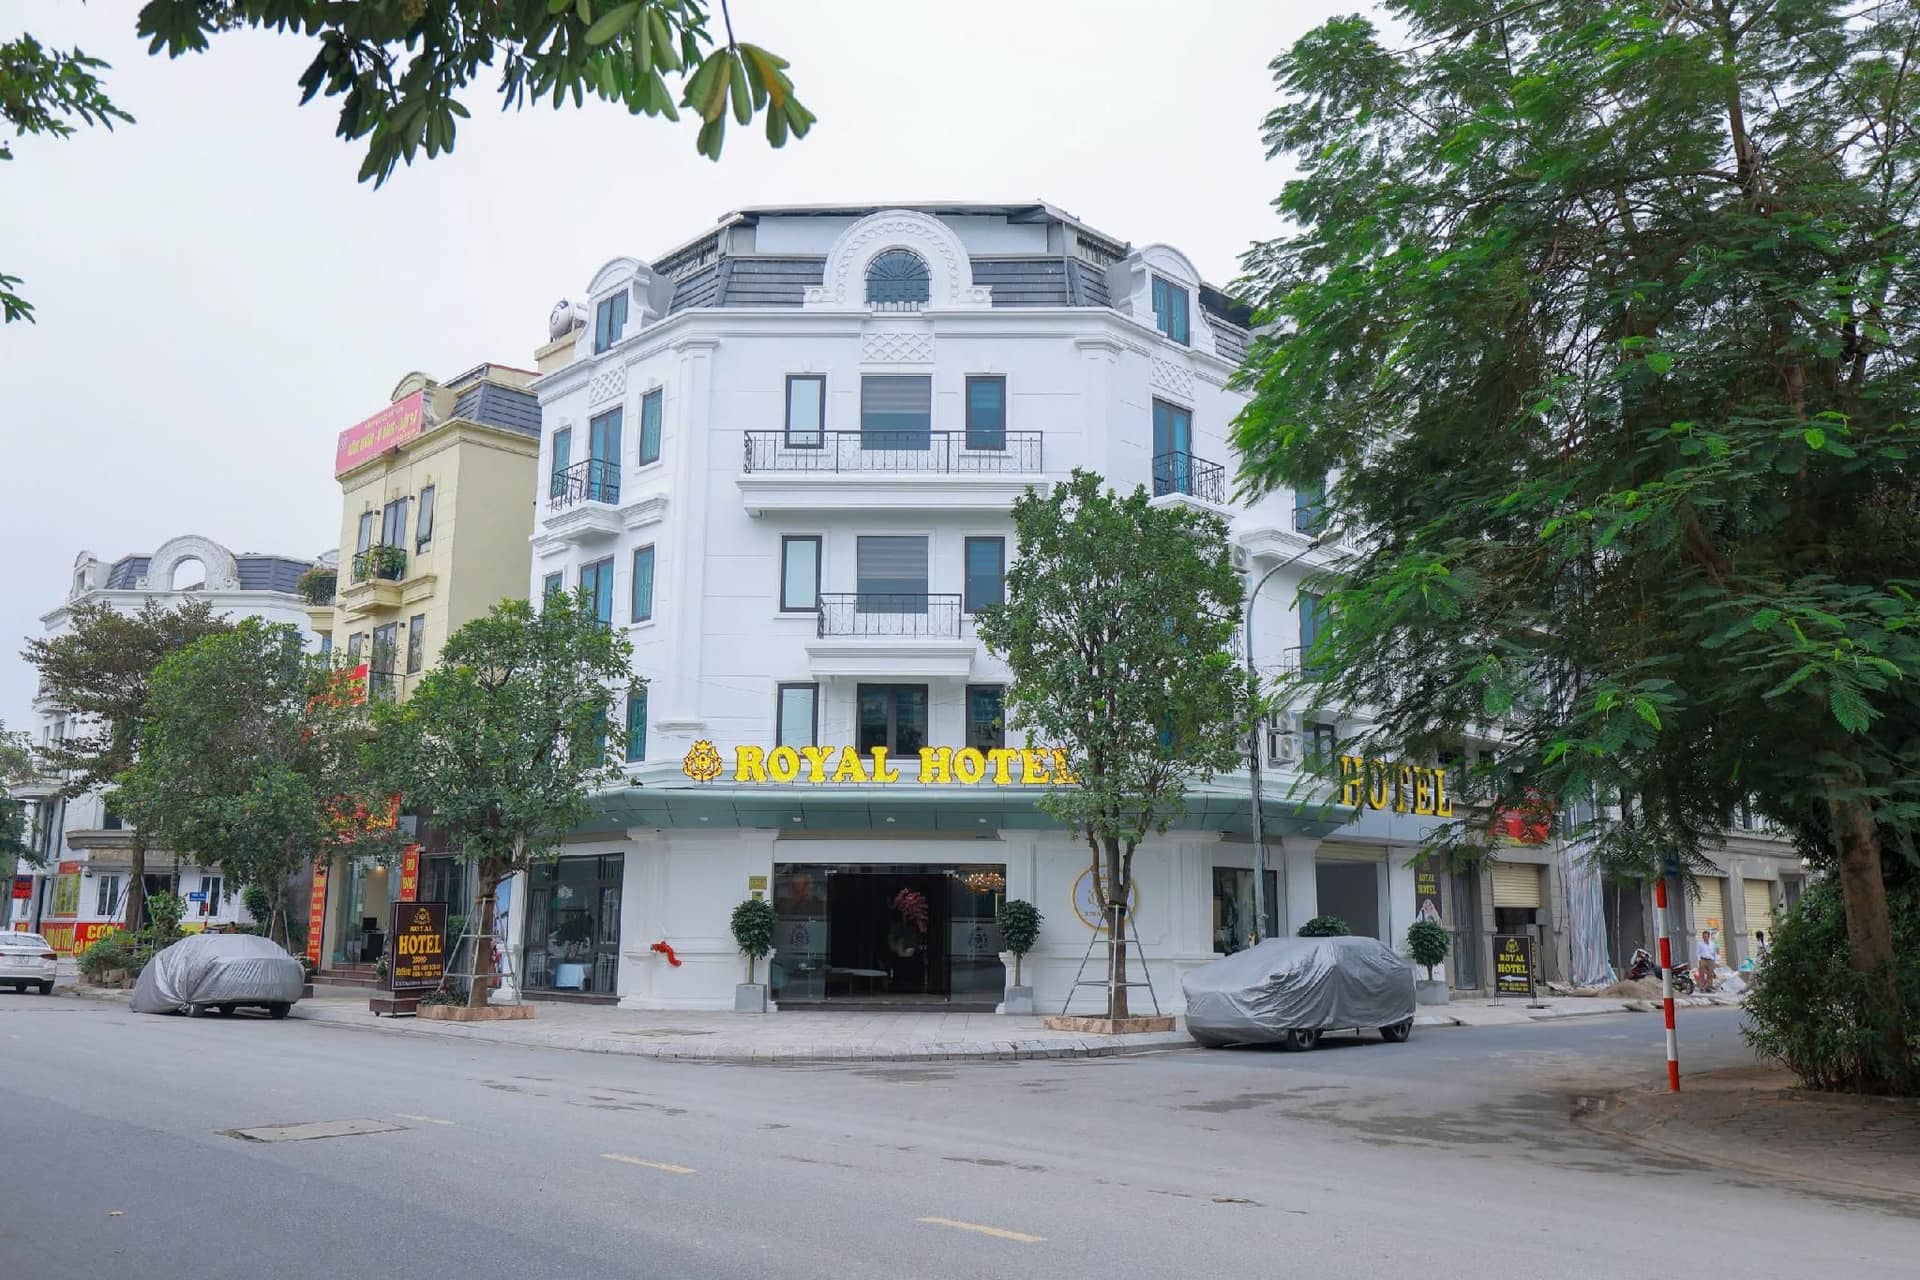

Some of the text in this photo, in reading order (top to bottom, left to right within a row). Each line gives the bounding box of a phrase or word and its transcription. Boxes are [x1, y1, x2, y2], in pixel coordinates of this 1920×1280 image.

[734, 745, 1080, 785] ROYAL HOTEL
[1340, 755, 1452, 817] HOTEL
[398, 934, 442, 955] HOTEL
[1499, 953, 1526, 962] ROYAL
[1497, 963, 1529, 974] HOTEL
